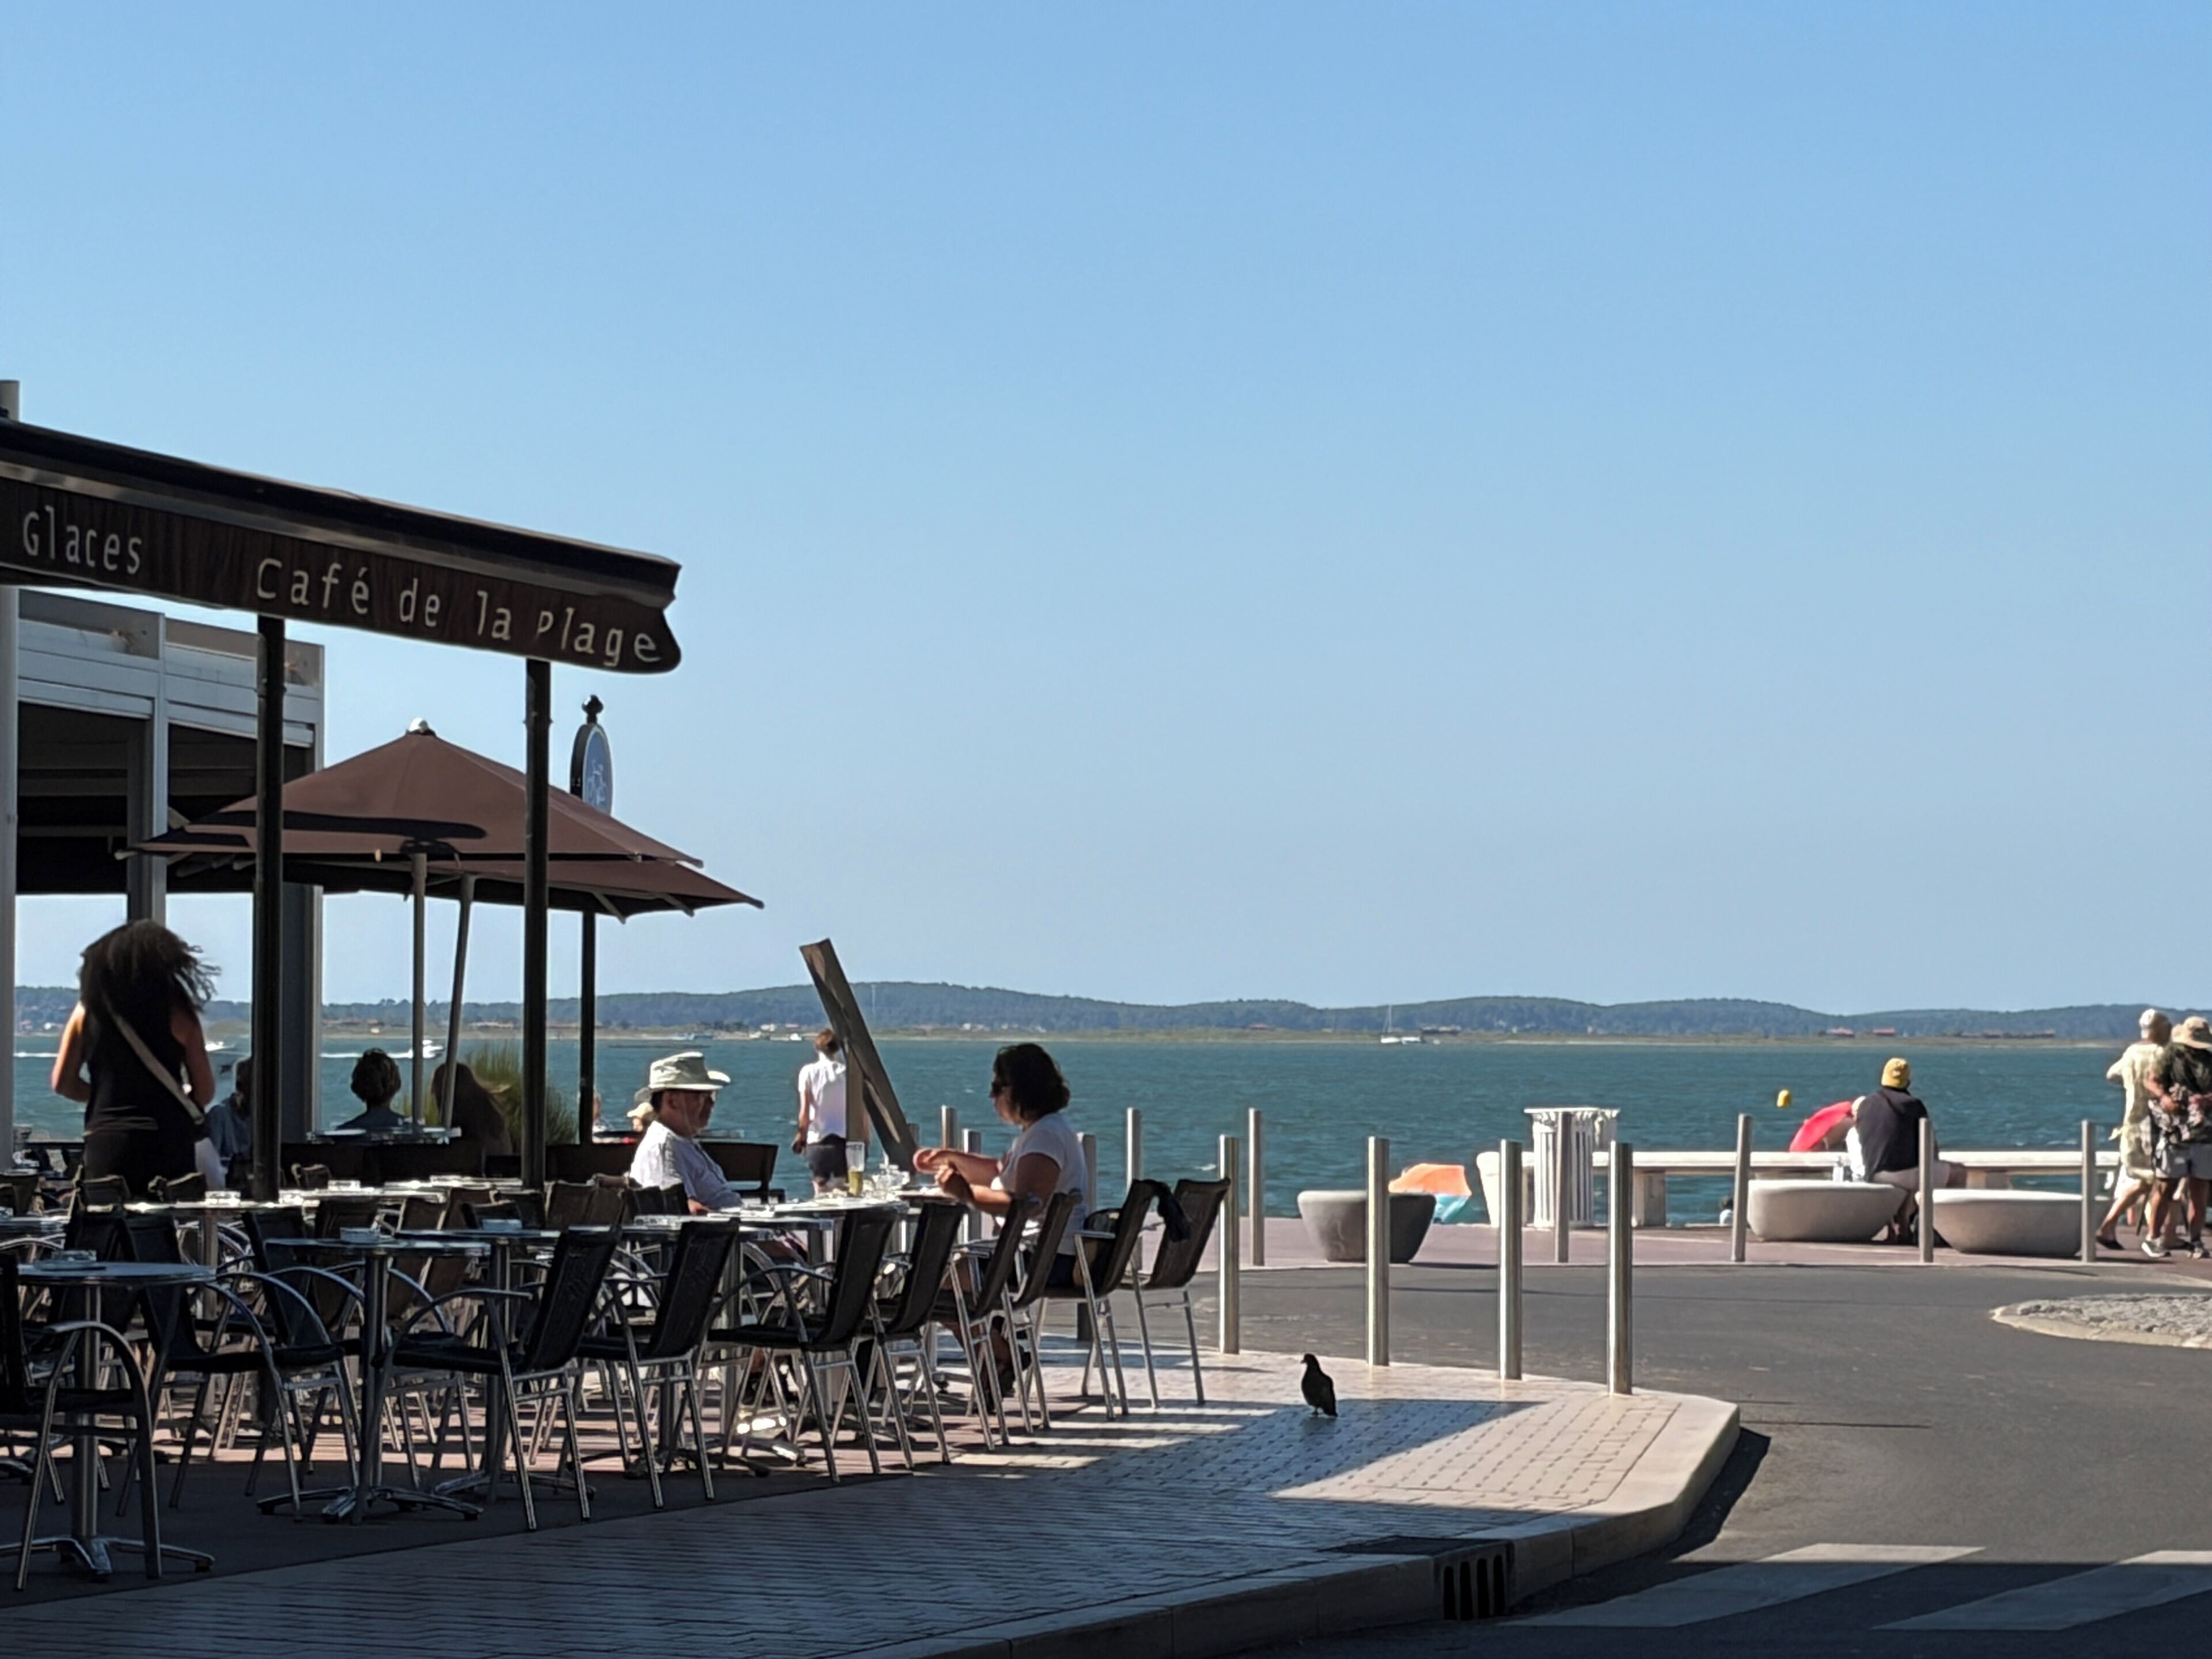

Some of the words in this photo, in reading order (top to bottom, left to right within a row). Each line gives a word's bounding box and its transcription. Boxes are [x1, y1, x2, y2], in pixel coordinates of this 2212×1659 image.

[22, 505, 142, 575] Glaces
[256, 558, 369, 615] Café
[399, 577, 441, 627] de
[476, 590, 512, 641] la
